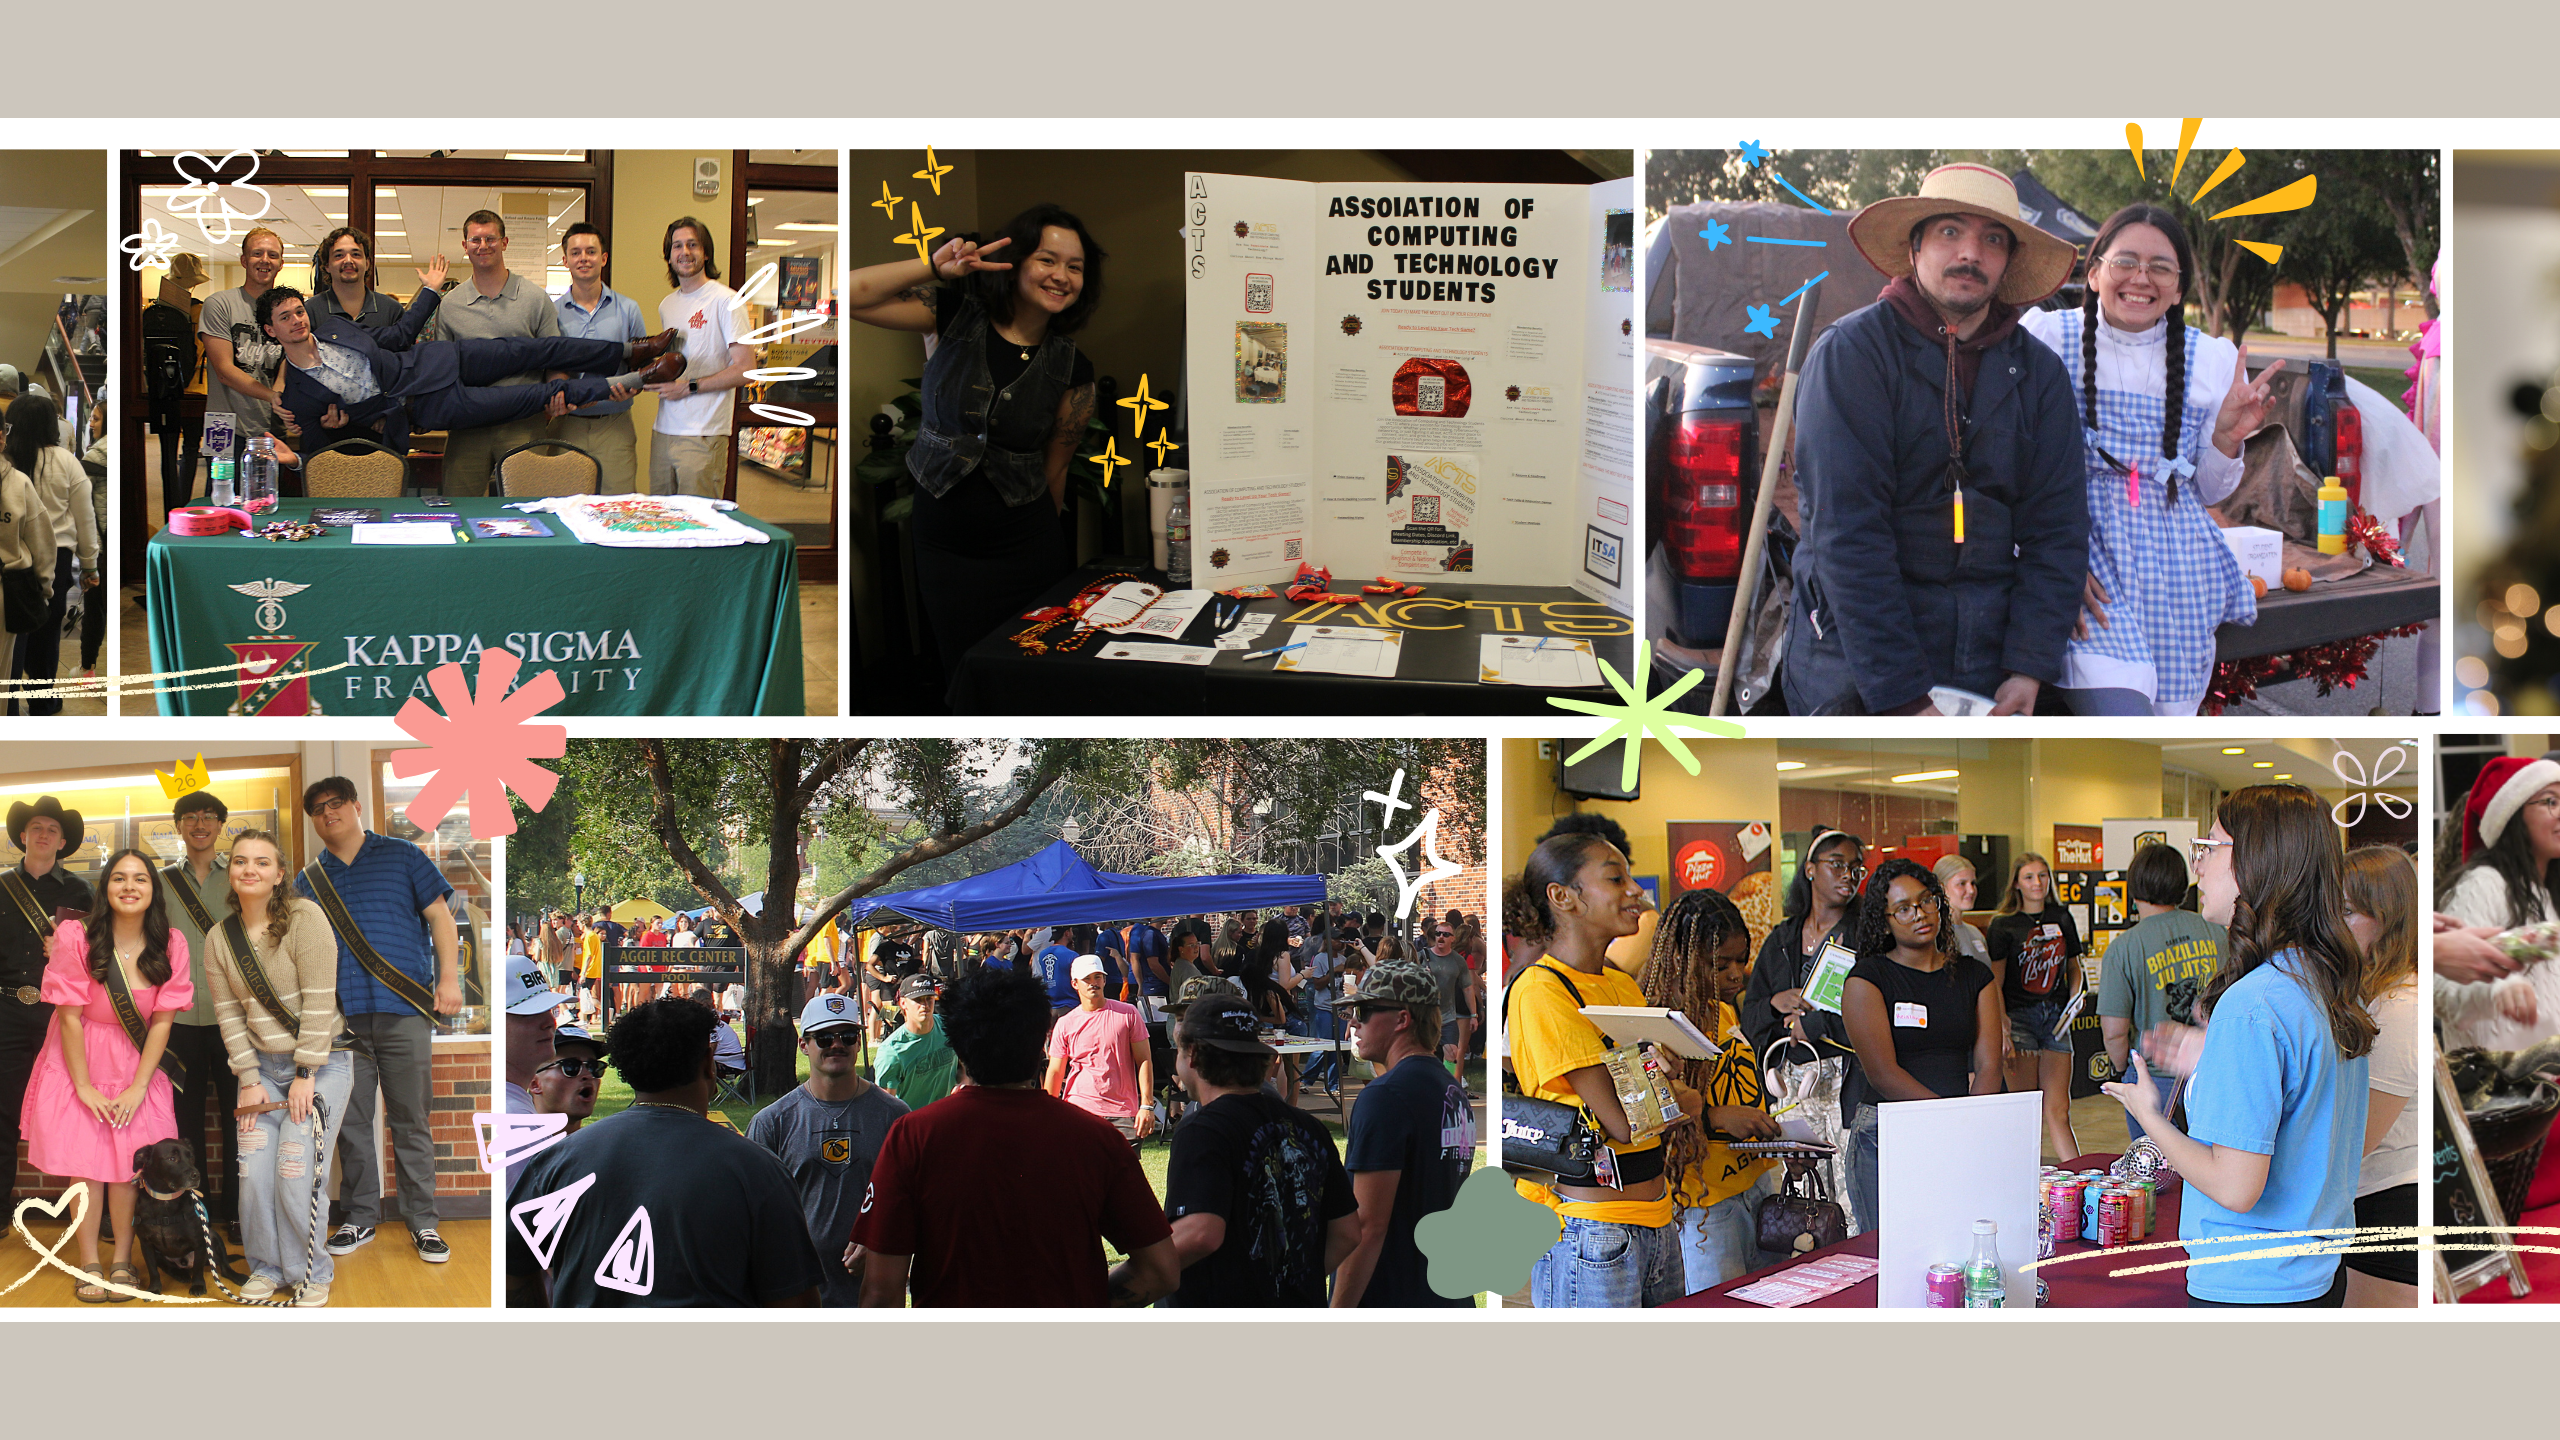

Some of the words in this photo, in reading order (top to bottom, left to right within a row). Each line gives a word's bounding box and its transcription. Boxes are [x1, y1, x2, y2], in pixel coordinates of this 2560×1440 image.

[1329, 196, 1480, 219] ASSOIATION
[1504, 198, 1534, 219] OF
[1190, 175, 1207, 279] ACTS
[1253, 223, 1277, 232] ACTS
[1367, 225, 1517, 247] COMPUTING
[1326, 254, 1373, 275] AND
[1394, 253, 1558, 279] TECHNOLOGY
[1367, 279, 1496, 303] STUDENTS
[1525, 387, 1550, 396] ACTS
[1413, 464, 1444, 487] ASSOCIATION
[1424, 457, 1476, 494] ACTS
[1408, 471, 1419, 480] AND
[1420, 478, 1450, 499] TECHNOLOGY
[1450, 497, 1475, 514] STUDENTS
[1592, 538, 1616, 559] ITSA
[1281, 598, 1634, 636] ACTS
[343, 633, 485, 667] KAPPA
[505, 628, 642, 663] SIGMA
[345, 668, 642, 699] FRARITY
[81, 835, 98, 844] AIA
[152, 831, 174, 841] NAIA
[1691, 871, 1711, 883] Hut
[2059, 883, 2081, 901] EC
[22, 897, 38, 917] POINT
[35, 917, 47, 932] USA
[189, 902, 210, 929] ACTS
[322, 890, 346, 927] CAMERON
[343, 923, 375, 964] TABLETOP
[373, 962, 407, 989] SOCIETY
[619, 950, 657, 963] AGGIE
[663, 950, 686, 963] REC
[689, 950, 736, 963] CENTER
[2018, 942, 2060, 967] Rolling
[2146, 940, 2218, 975] BRAZILIAN
[661, 973, 695, 982] POOL
[2155, 966, 2176, 991] JIU
[2180, 957, 2218, 981] JITSU
[241, 955, 269, 1004] OMEGA
[269, 1005, 299, 1036] ZETA
[113, 992, 141, 1034] ALPHA
[1222, 1010, 1248, 1019] Whiskey
[2433, 1141, 2459, 1165] ents
